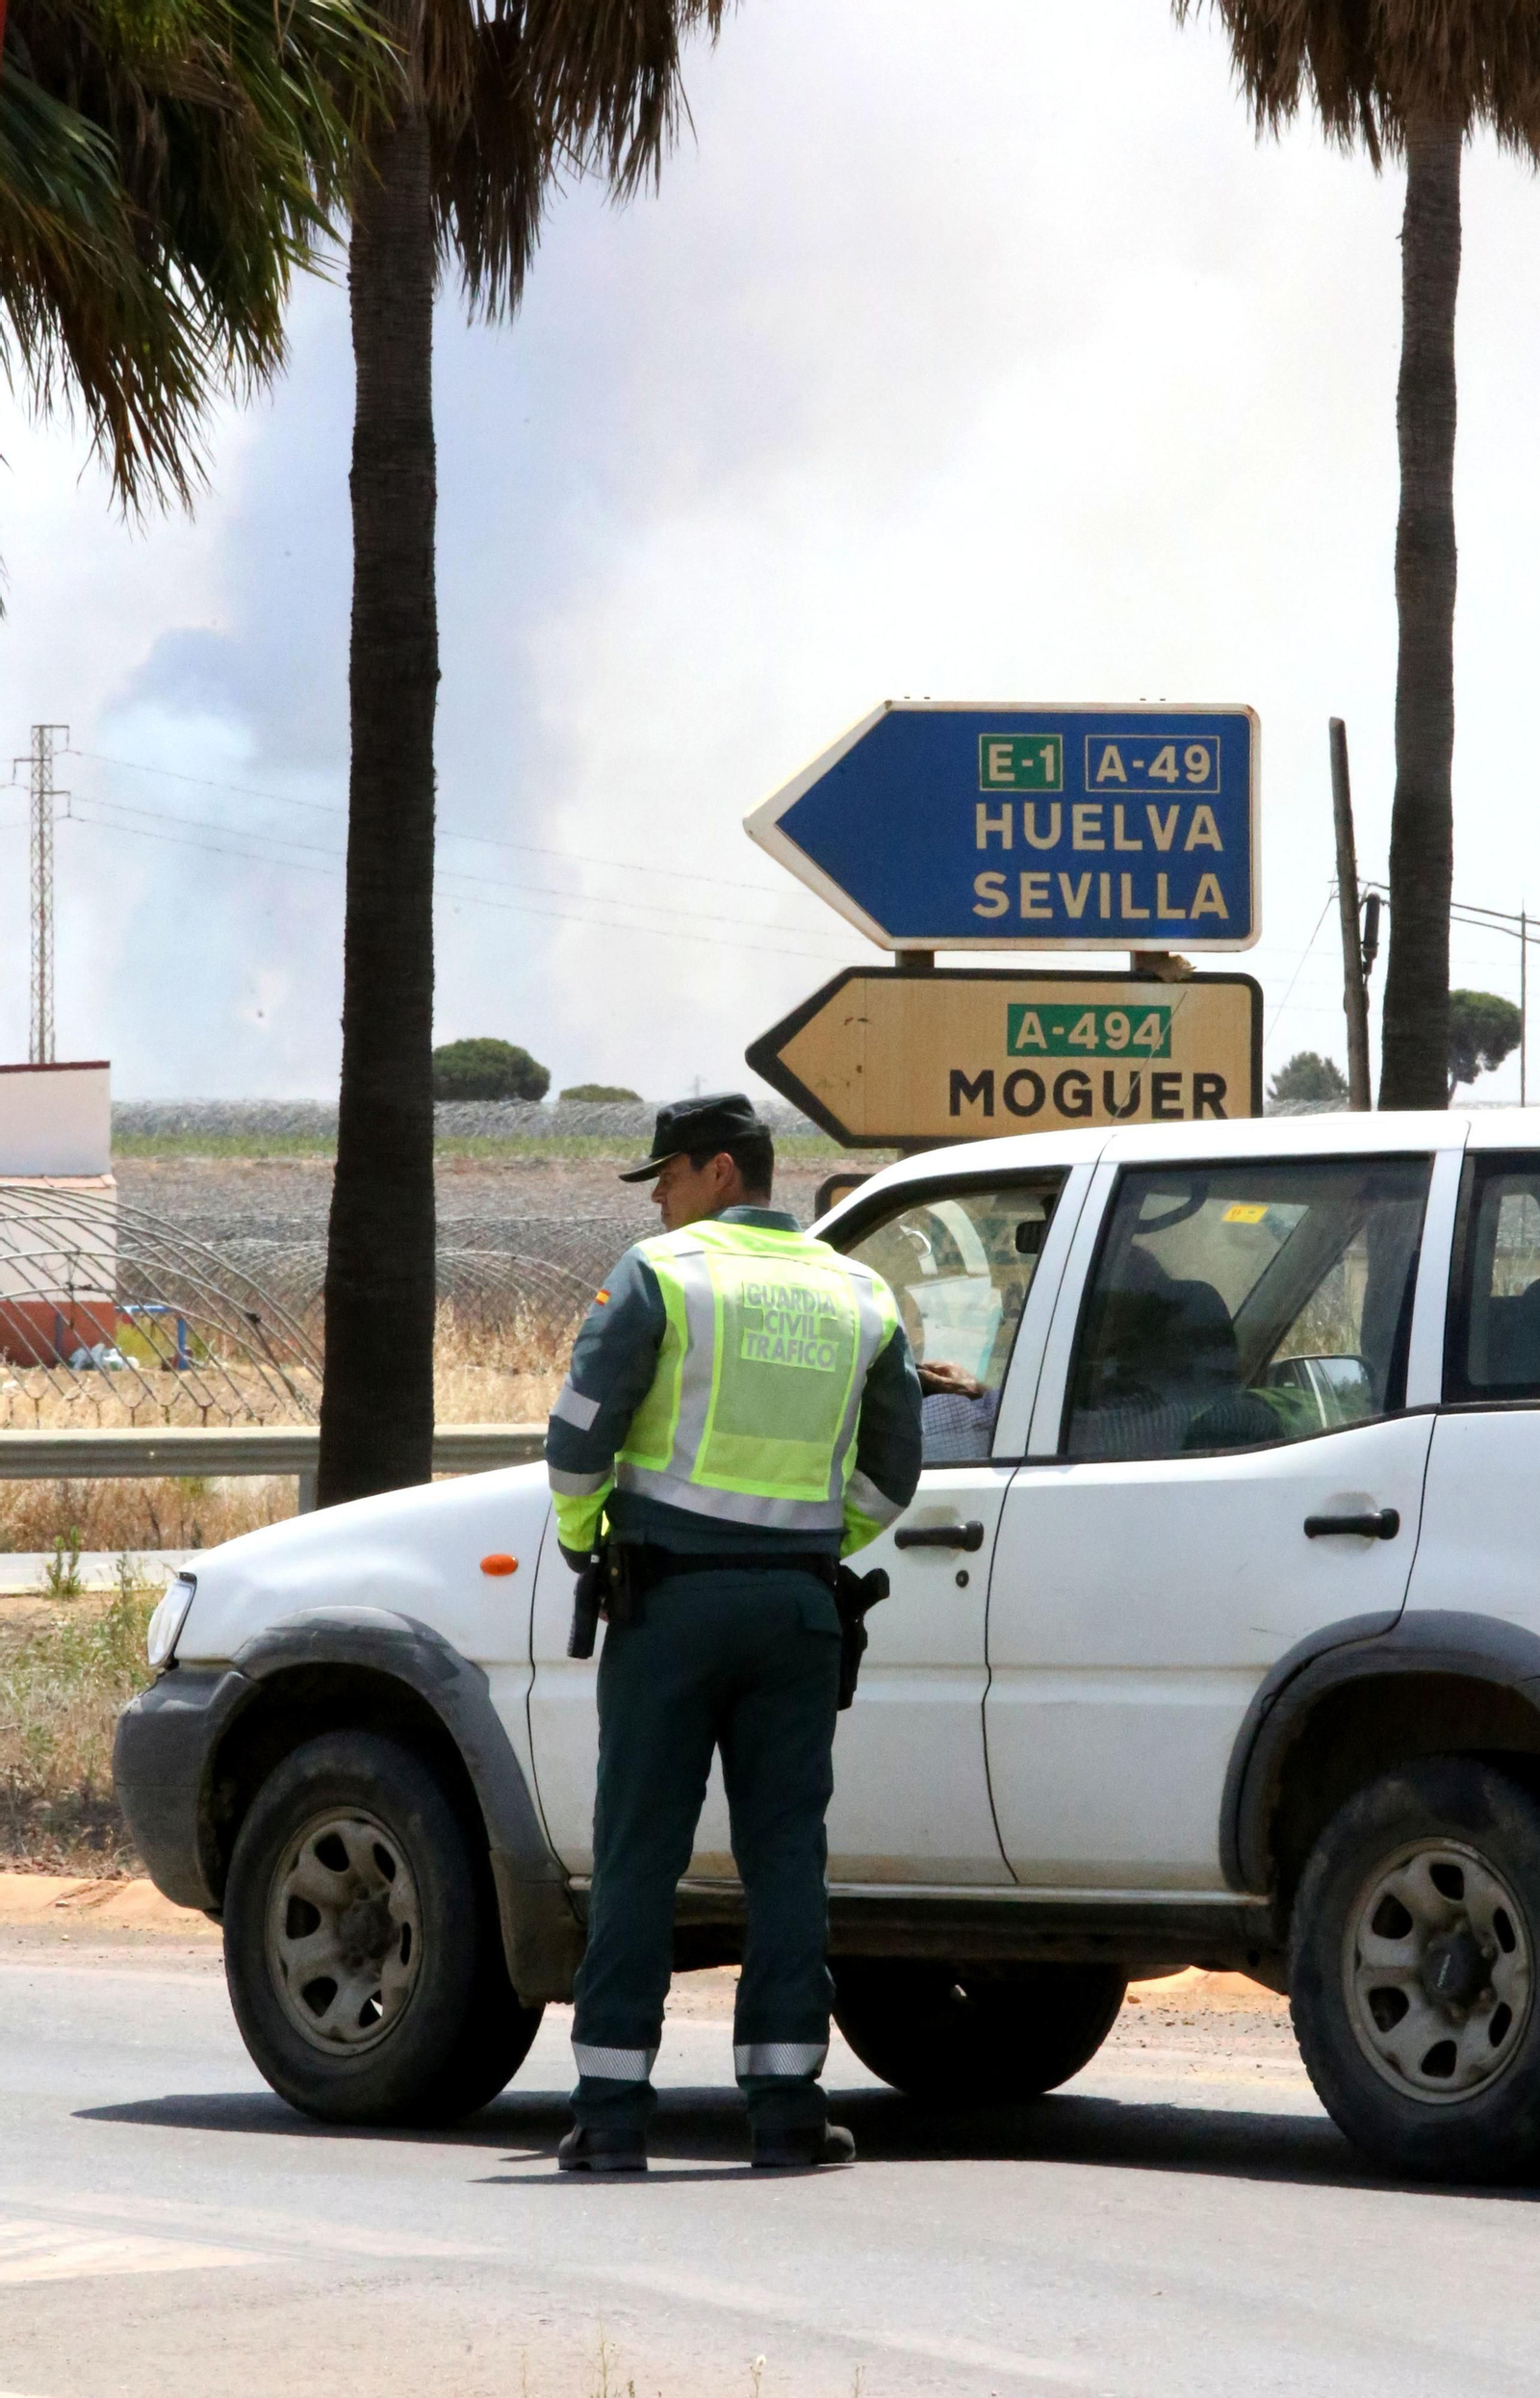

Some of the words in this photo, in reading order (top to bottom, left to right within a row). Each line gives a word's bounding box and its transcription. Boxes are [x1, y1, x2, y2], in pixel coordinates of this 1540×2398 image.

[988, 743, 1055, 782] E-1
[1096, 744, 1211, 784] A-49
[975, 802, 1223, 852] HUELVA
[972, 871, 1229, 919] SEVILLA
[1014, 1011, 1165, 1051] A-494
[949, 1068, 1229, 1120] MOGUER
[746, 1282, 836, 1315] GUARDIA
[764, 1309, 820, 1340] CIVIL
[746, 1332, 834, 1367] TRAFICO
